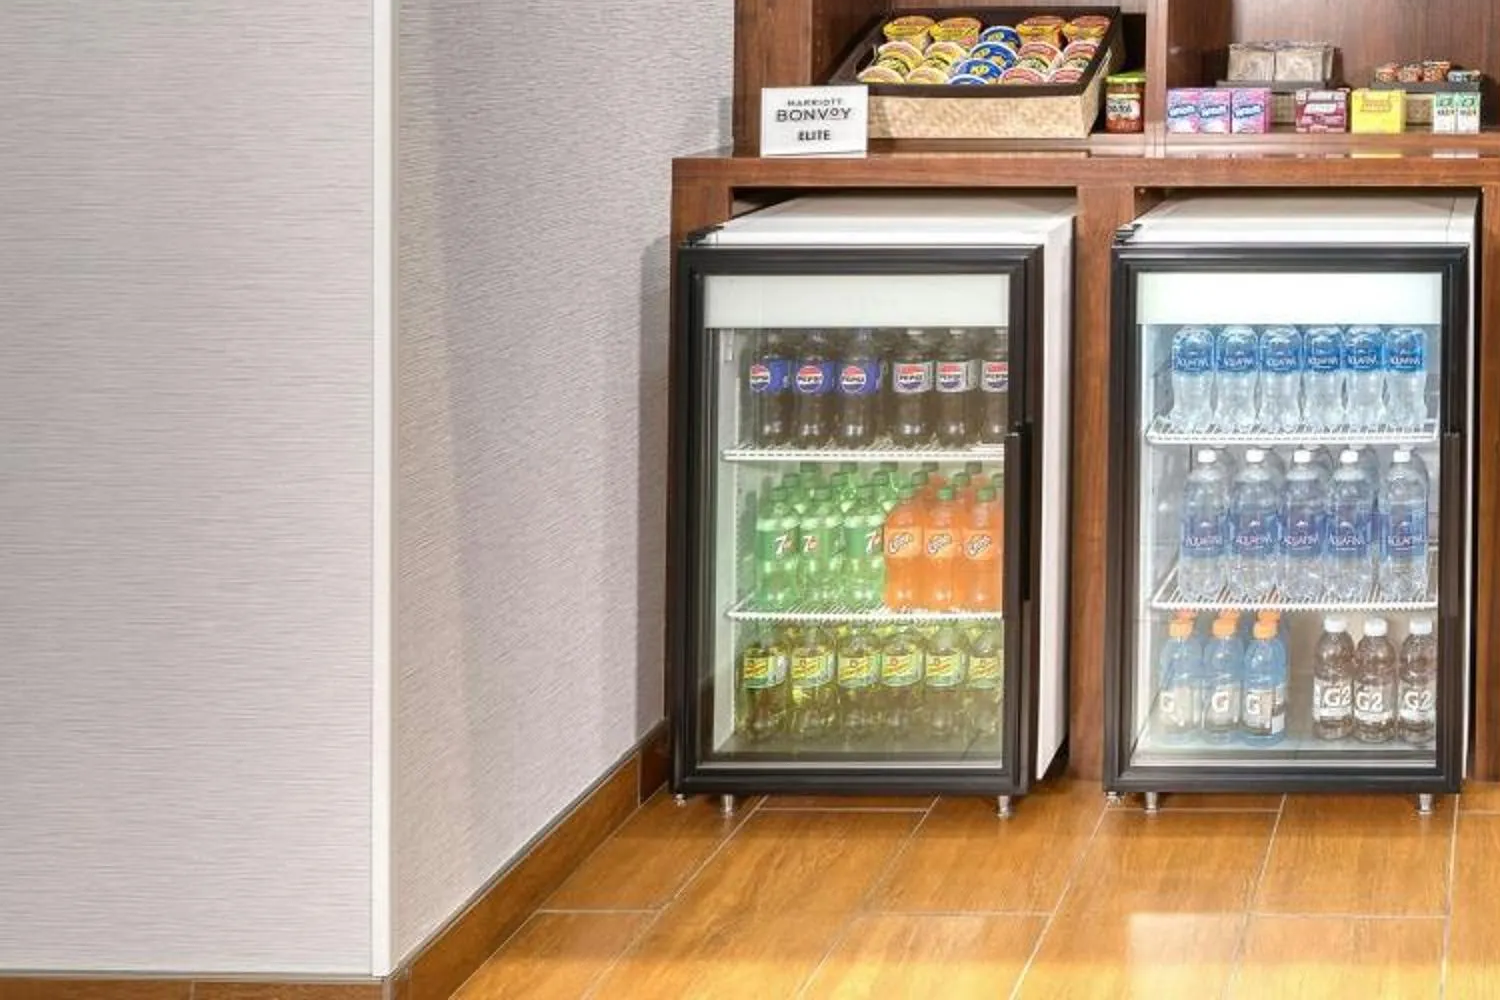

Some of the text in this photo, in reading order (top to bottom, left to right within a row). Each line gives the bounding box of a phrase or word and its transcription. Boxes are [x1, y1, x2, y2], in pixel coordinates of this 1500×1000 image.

[787, 97, 843, 107] MARRIOTT
[776, 107, 852, 122] BONVOY
[797, 129, 832, 142] ELITE
[1211, 691, 1229, 713] G
[1323, 685, 1351, 707] G2
[1355, 691, 1383, 713] G2
[1403, 689, 1433, 710] G2
